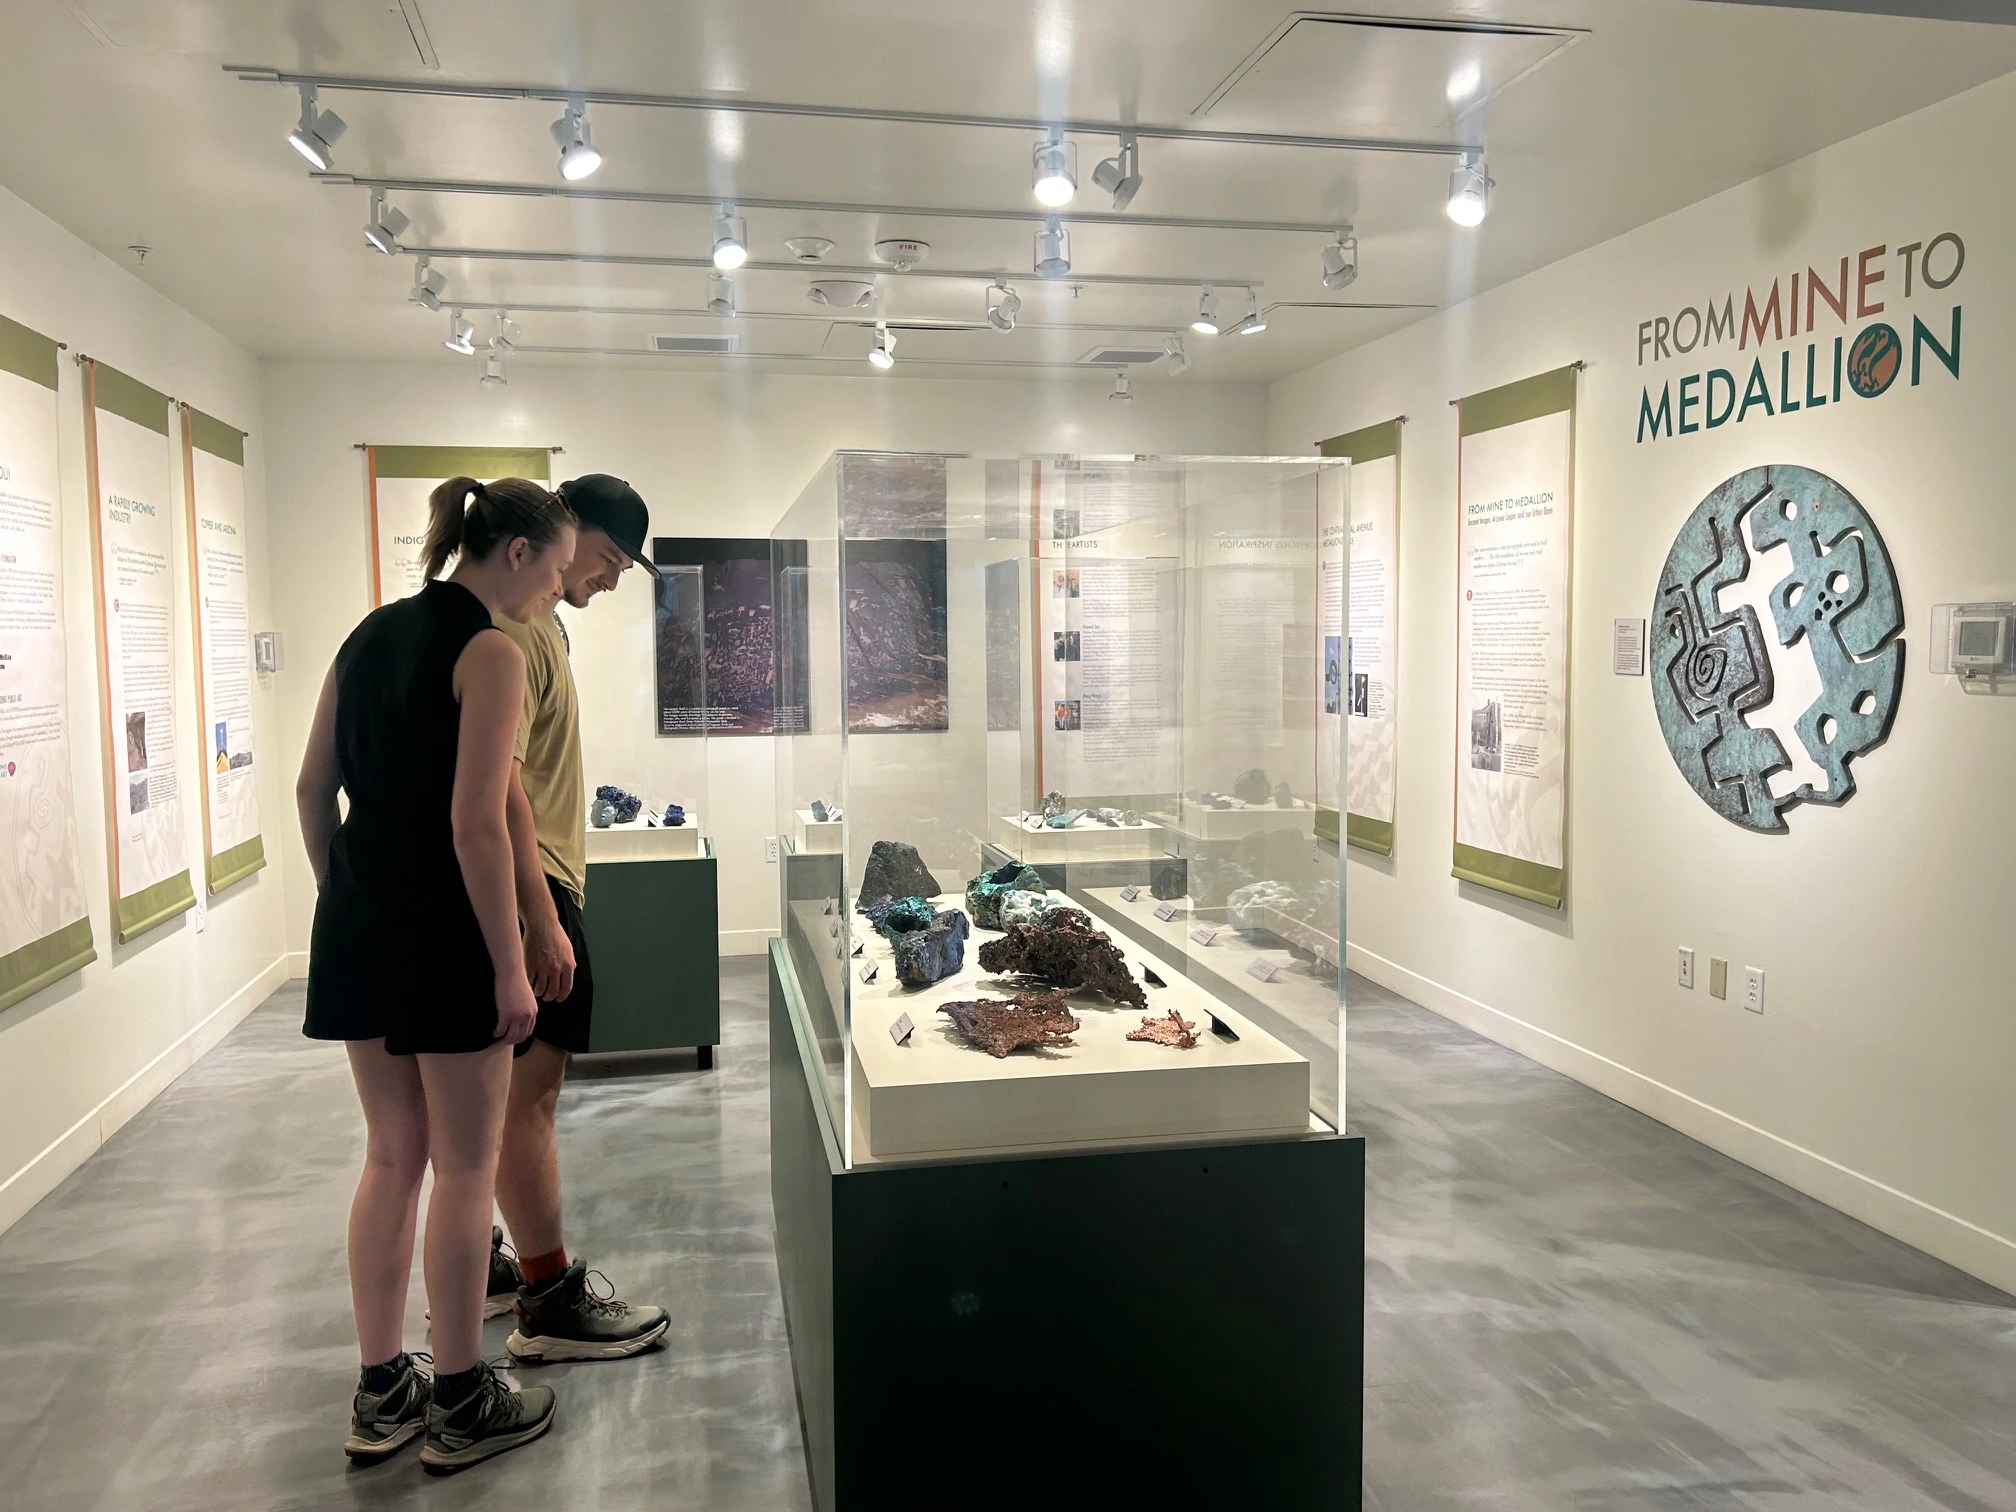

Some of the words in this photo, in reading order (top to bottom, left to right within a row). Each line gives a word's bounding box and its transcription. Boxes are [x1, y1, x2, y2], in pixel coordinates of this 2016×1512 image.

[1638, 291, 1735, 366] FROM
[1738, 244, 1886, 351] MINE
[1897, 232, 1966, 298] TO
[1637, 305, 1962, 444] MEDALLION
[131, 501, 155, 517] GROWING
[1468, 504, 1486, 516] FROM
[1486, 500, 1504, 512] MINE
[1505, 498, 1514, 509] TO
[1515, 492, 1554, 508] MEDALLION
[108, 509, 131, 524] INDUSTRY
[1356, 521, 1374, 533] AVENUE
[1072, 540, 1098, 549] ARTISTS
